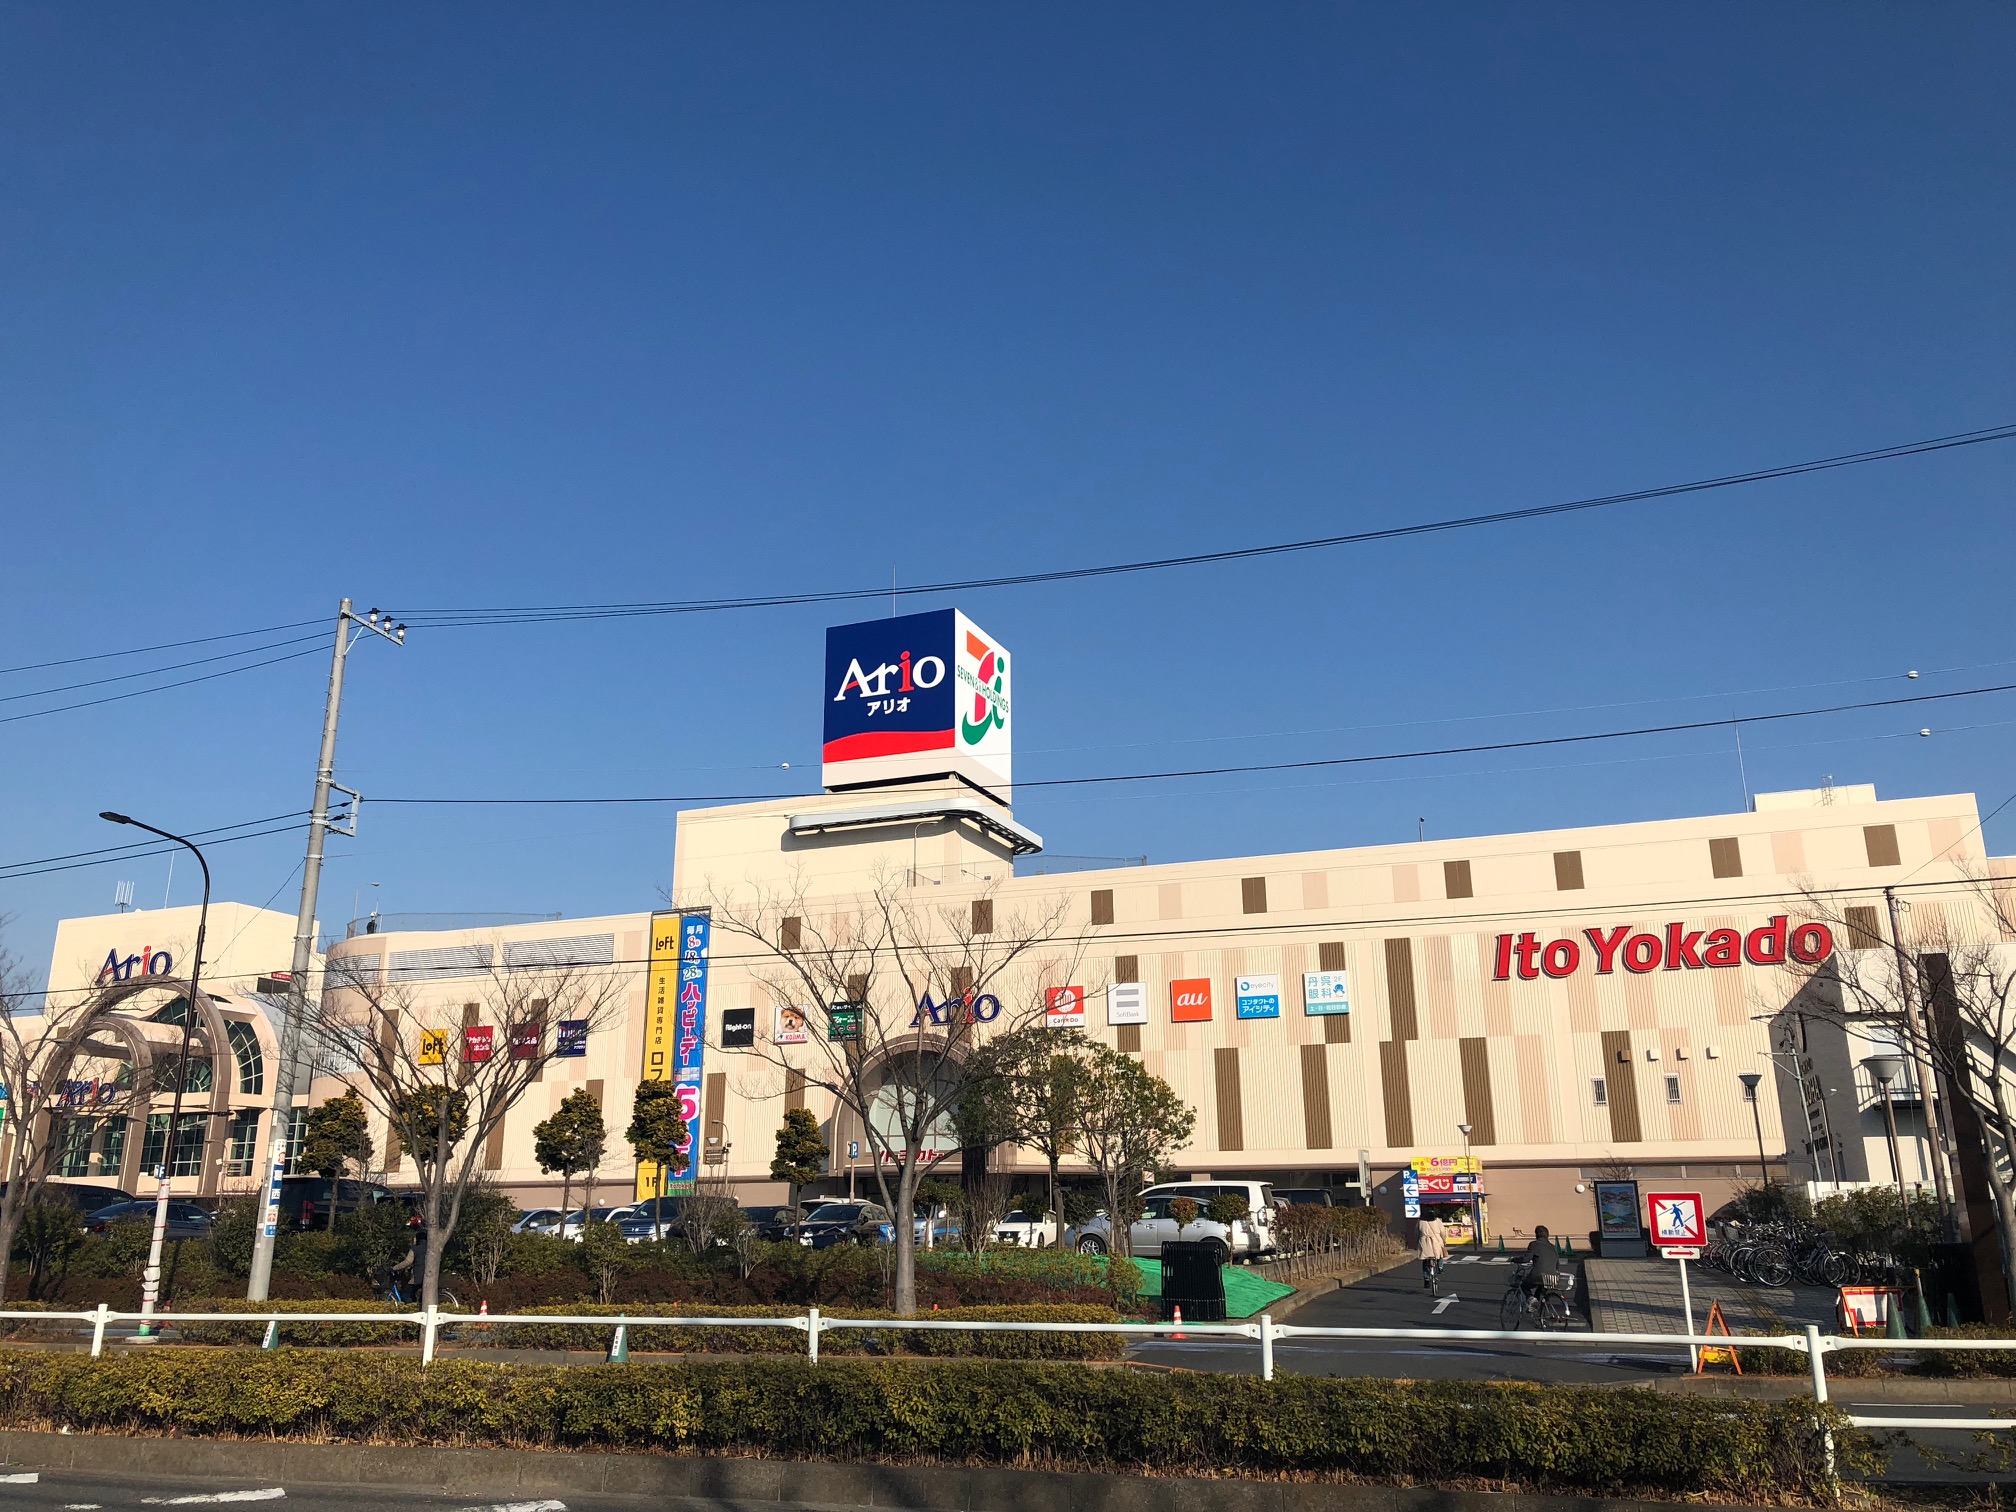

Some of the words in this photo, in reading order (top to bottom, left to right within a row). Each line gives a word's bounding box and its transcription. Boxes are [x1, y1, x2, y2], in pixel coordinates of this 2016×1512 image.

[834, 650, 946, 702] Ario
[982, 683, 1010, 714] HOLDINGS
[867, 697, 911, 717] アリオ
[687, 924, 704, 935] 毎月
[655, 936, 674, 951] Loft
[95, 945, 173, 987] Ario
[1250, 981, 1275, 990] eyecity
[1308, 975, 1332, 987] 丹呉
[1334, 975, 1343, 983] 2F
[1176, 992, 1208, 1007] au
[1308, 987, 1332, 999] 眼科
[908, 987, 1002, 1028] Ario
[1241, 997, 1275, 1006] コンタクトの
[654, 976, 667, 1045] 生活雑貨専門店
[1241, 1005, 1275, 1014] アイシティ
[680, 982, 702, 1065] ハッピーデー
[785, 1033, 806, 1041] KOJIMA
[422, 1037, 443, 1056] Loft
[55, 1077, 117, 1106] Ario
